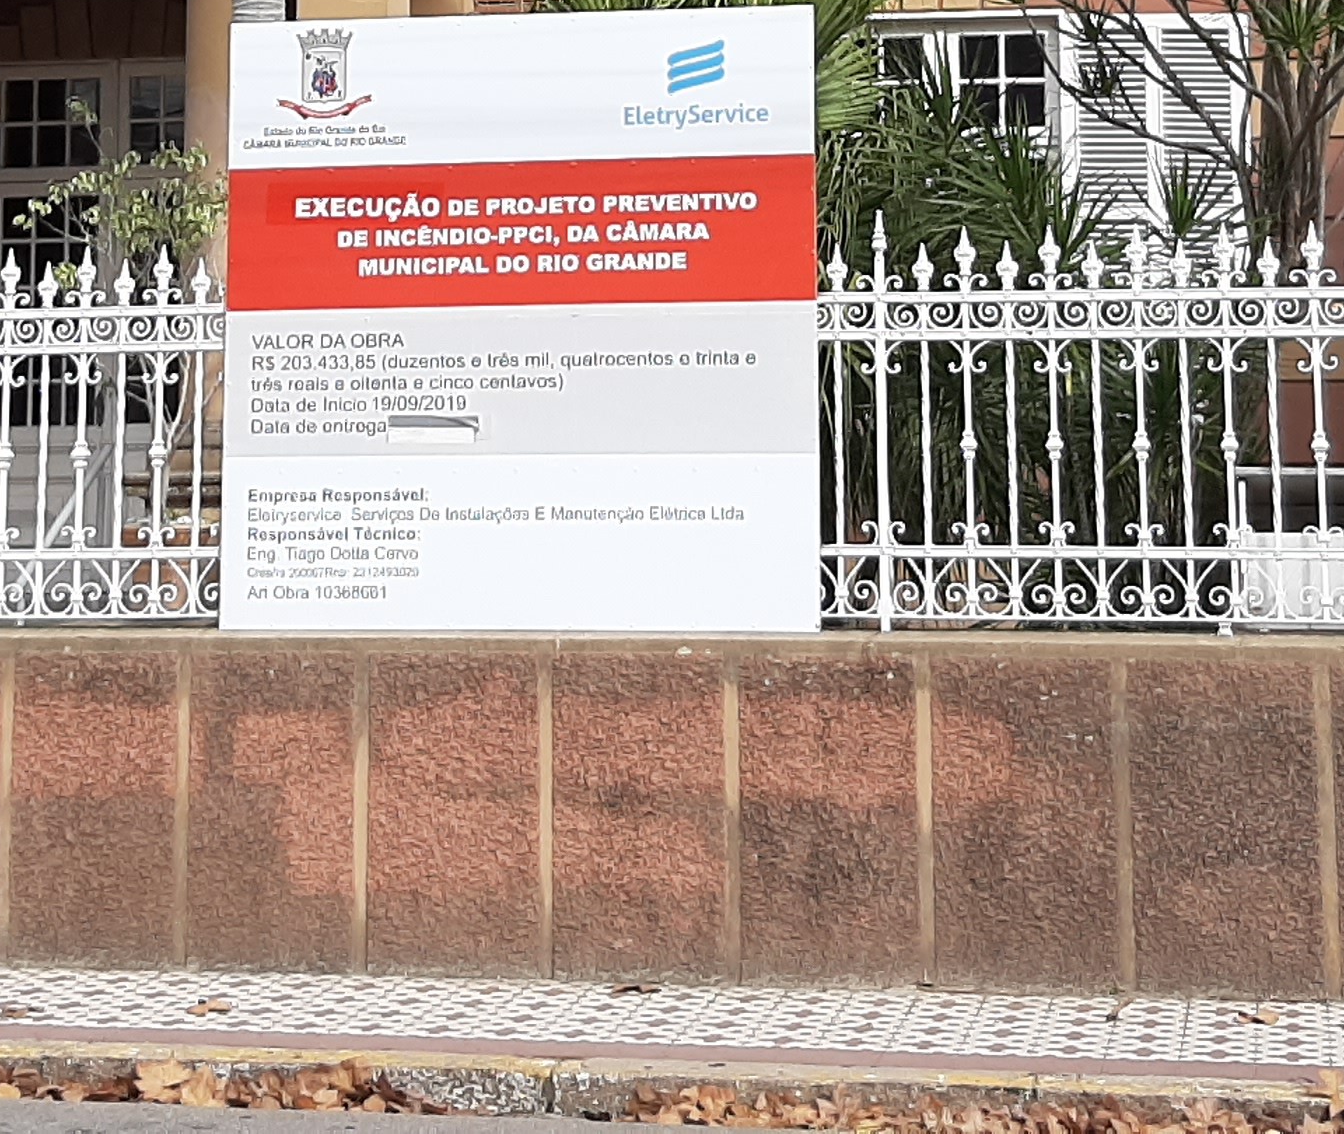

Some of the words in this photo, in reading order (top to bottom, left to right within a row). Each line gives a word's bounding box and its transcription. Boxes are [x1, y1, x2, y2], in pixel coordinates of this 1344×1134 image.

[623, 102, 769, 130] EletryService
[295, 190, 441, 223] EXECUÇÃO
[447, 198, 480, 217] DE
[485, 195, 596, 216] PROJETO
[603, 191, 758, 213] PREVENTIVO
[337, 229, 369, 248] DE
[375, 225, 560, 247] INCÊNDIO-PPCI,
[567, 224, 600, 243] DA
[606, 220, 710, 242] CÂMARA
[358, 256, 490, 278] MUNICIPAL
[496, 254, 530, 274] DO
[537, 253, 580, 273] RIO
[585, 251, 687, 272] GRANDE
[251, 333, 314, 350] VALOR
[320, 333, 347, 349] DA
[350, 332, 405, 349] OBRA
[252, 355, 275, 371] R$
[280, 354, 376, 372] 203.433,85
[381, 354, 466, 371] (duzentos
[487, 352, 519, 368] três
[525, 351, 554, 370] mil,
[558, 352, 674, 371] quatrocentos
[696, 350, 740, 366] trinta
[745, 353, 756, 365] e
[251, 376, 283, 392] três
[288, 376, 329, 391] reais
[334, 379, 345, 391] e
[350, 375, 408, 391] oitenta
[413, 378, 424, 390] e
[429, 374, 474, 391] cinco
[479, 373, 564, 392] centavos)
[250, 397, 290, 413] Data
[295, 397, 317, 413] de
[372, 394, 467, 412] 19/09/2019
[250, 418, 290, 435] Data
[295, 418, 318, 434] de
[322, 418, 389, 437] entrega
[248, 488, 317, 506] Empresa
[322, 487, 428, 505] Responsável:
[351, 506, 415, 525] Serviços
[419, 506, 440, 521] De
[445, 506, 530, 525] Instalações
[534, 505, 546, 521] E
[551, 505, 645, 524] Manutenção
[711, 505, 745, 521] Ltda
[247, 526, 349, 545] Responsável
[353, 526, 421, 541] Técnico:
[284, 546, 326, 565] Tiago
[330, 546, 370, 561] Dotta
[272, 585, 310, 600] Obra
